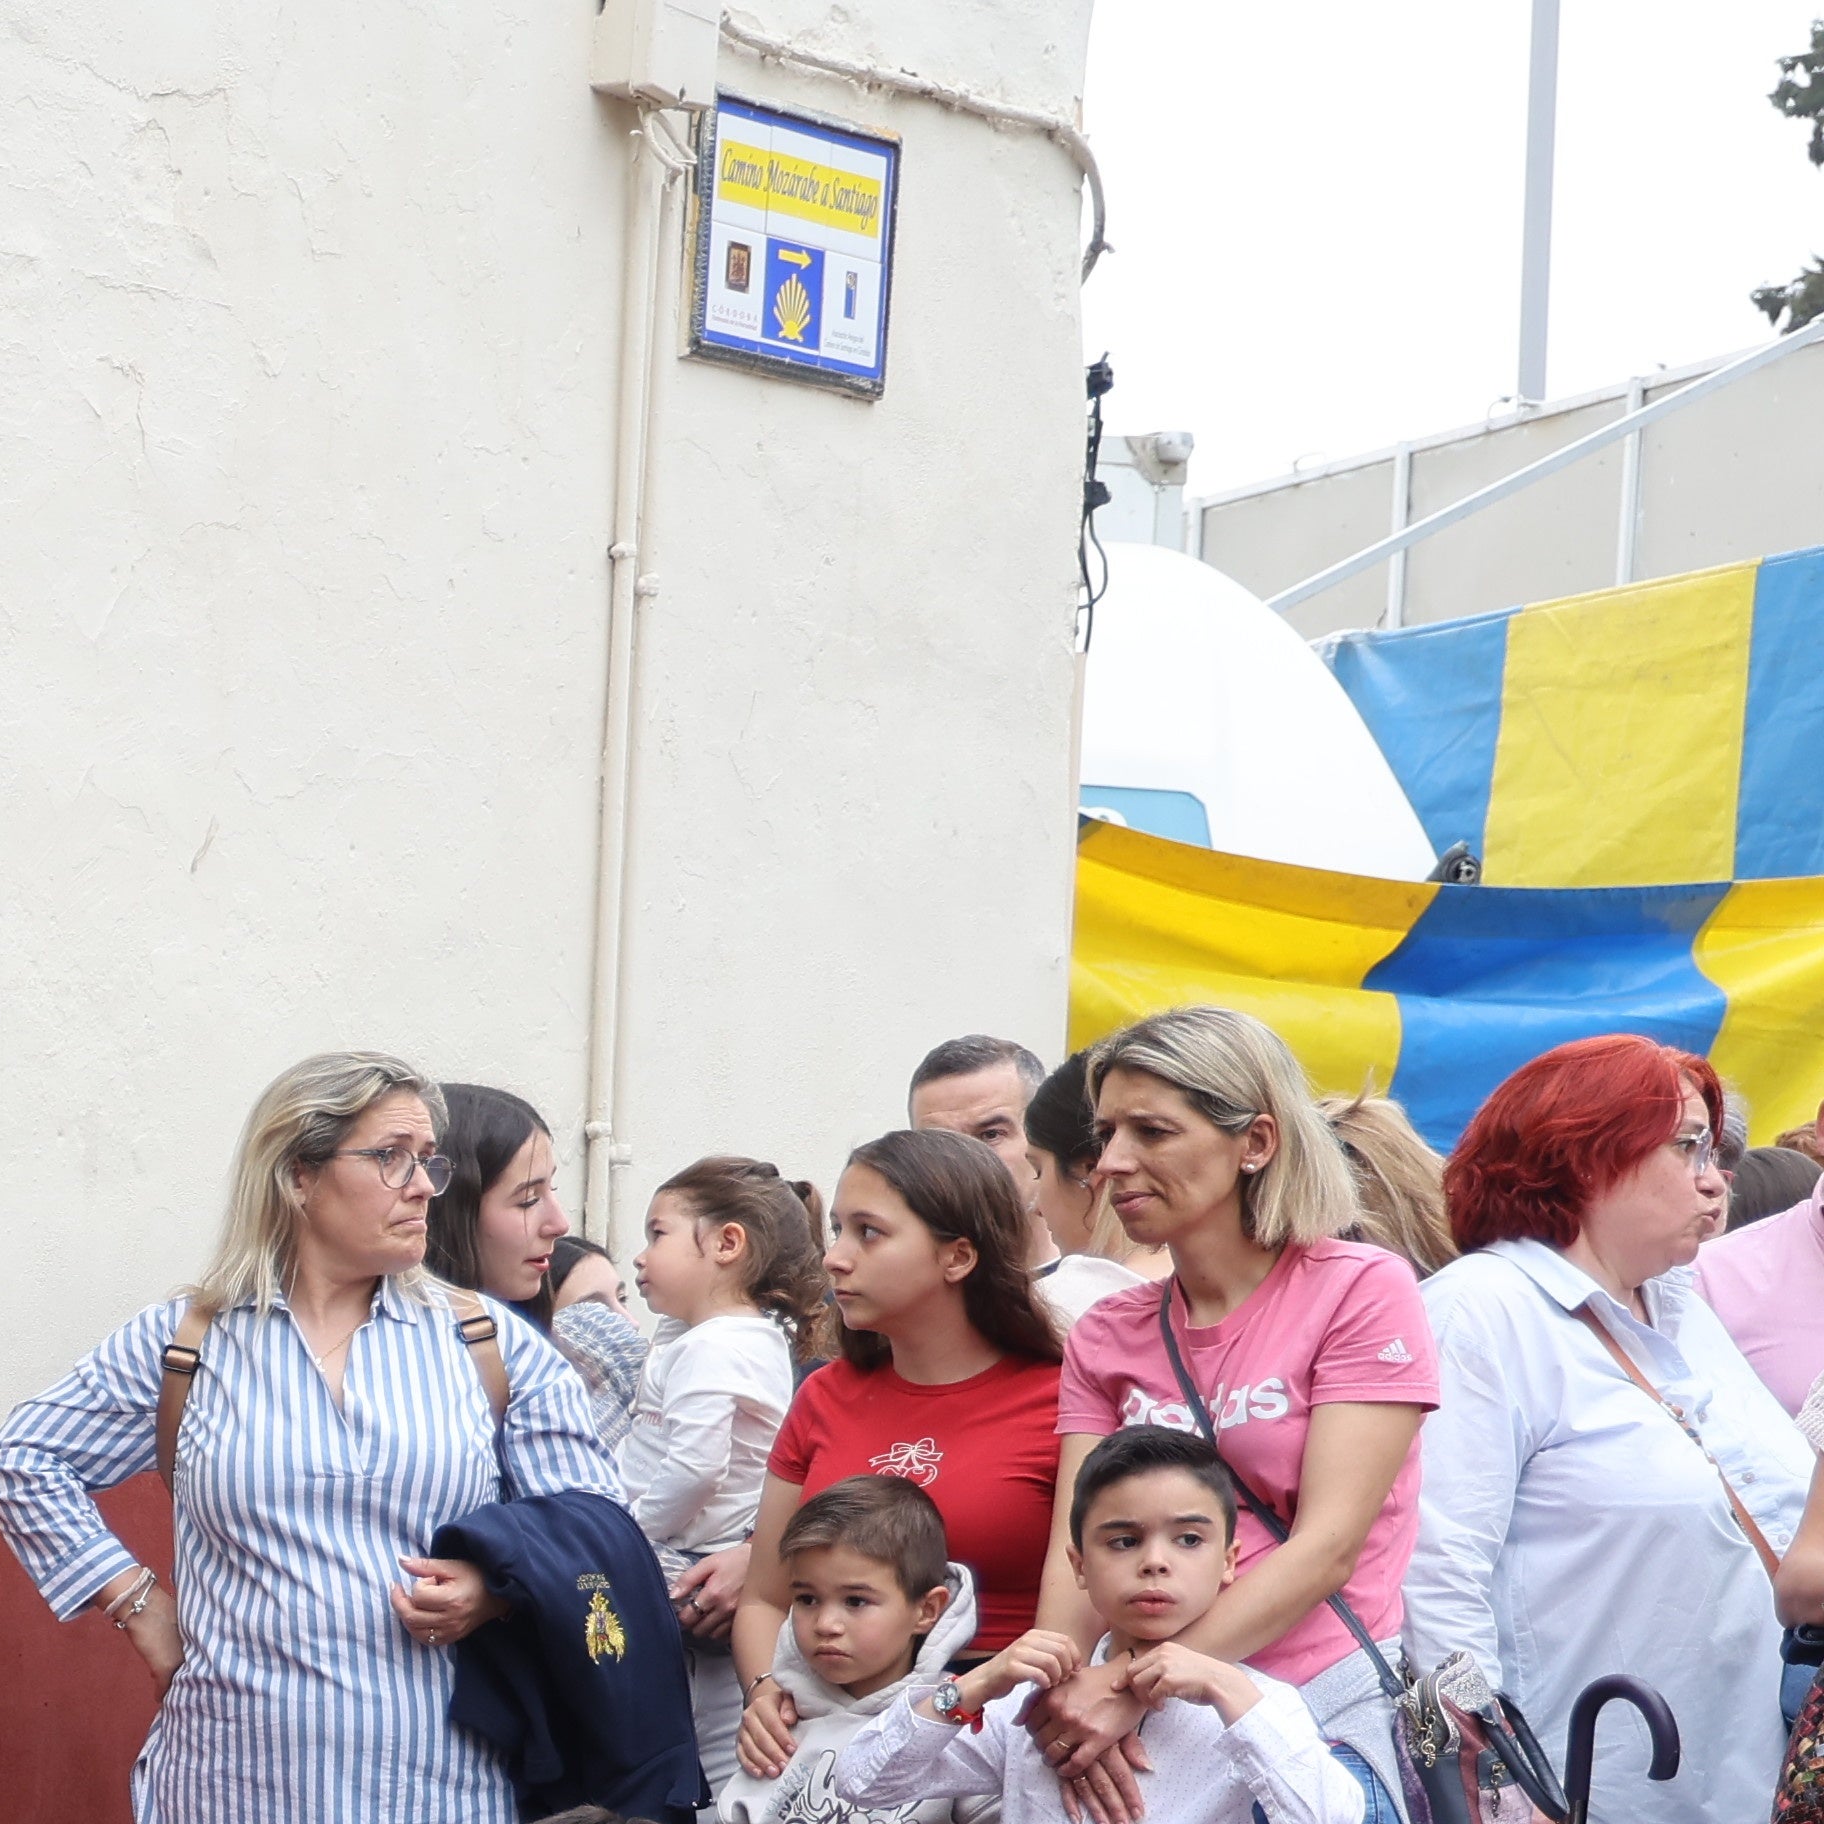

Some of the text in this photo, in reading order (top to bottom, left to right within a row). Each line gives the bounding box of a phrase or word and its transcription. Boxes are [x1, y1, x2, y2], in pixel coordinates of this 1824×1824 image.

[721, 148, 879, 230] Camino Mozárabe a Santiago
